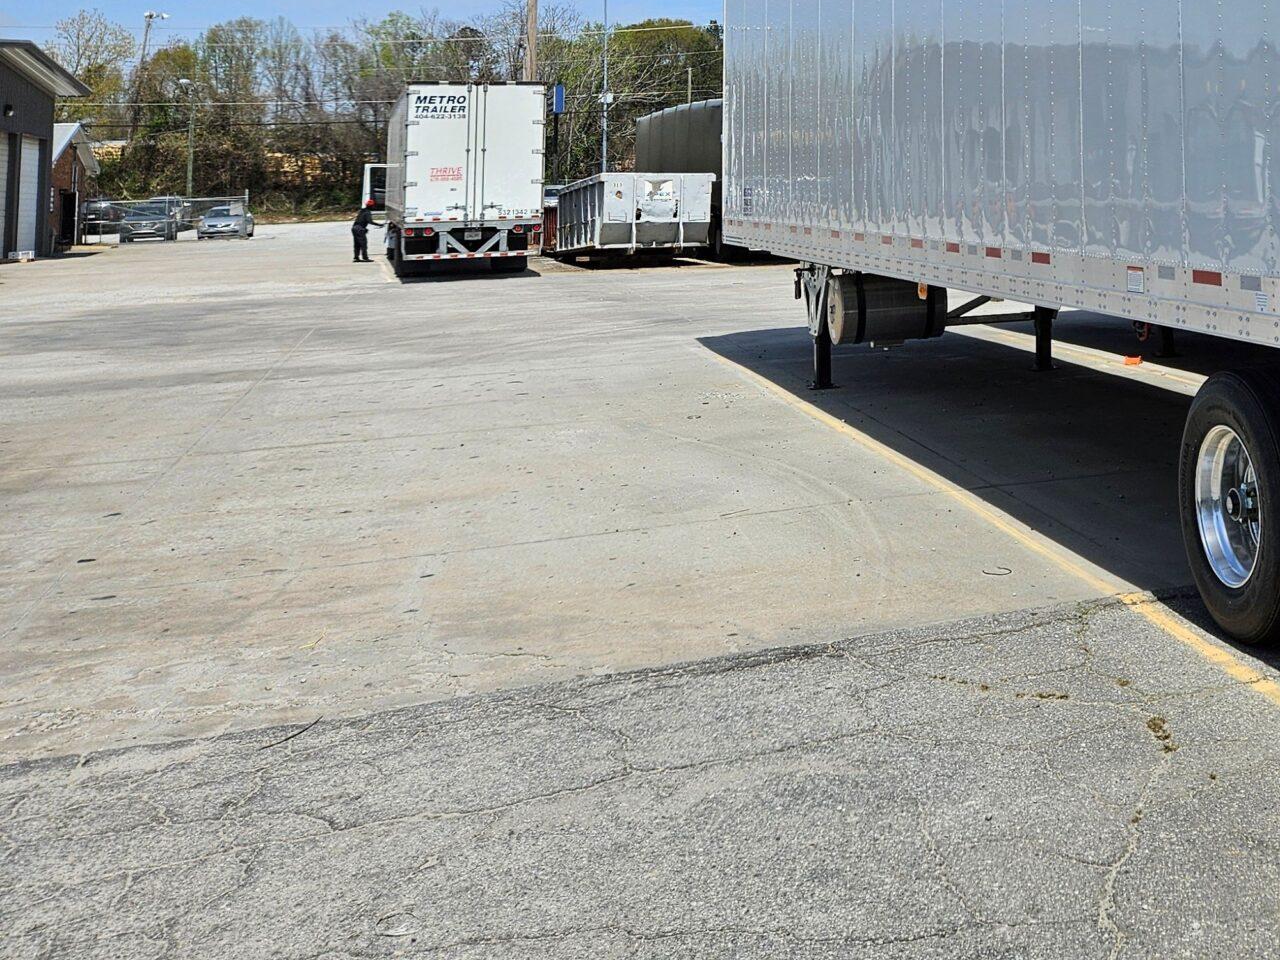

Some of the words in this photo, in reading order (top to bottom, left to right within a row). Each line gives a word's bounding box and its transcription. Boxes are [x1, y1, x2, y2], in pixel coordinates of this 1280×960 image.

[415, 95, 467, 105] METRO
[414, 105, 467, 113] TRAILER
[430, 166, 463, 175] THRIVE
